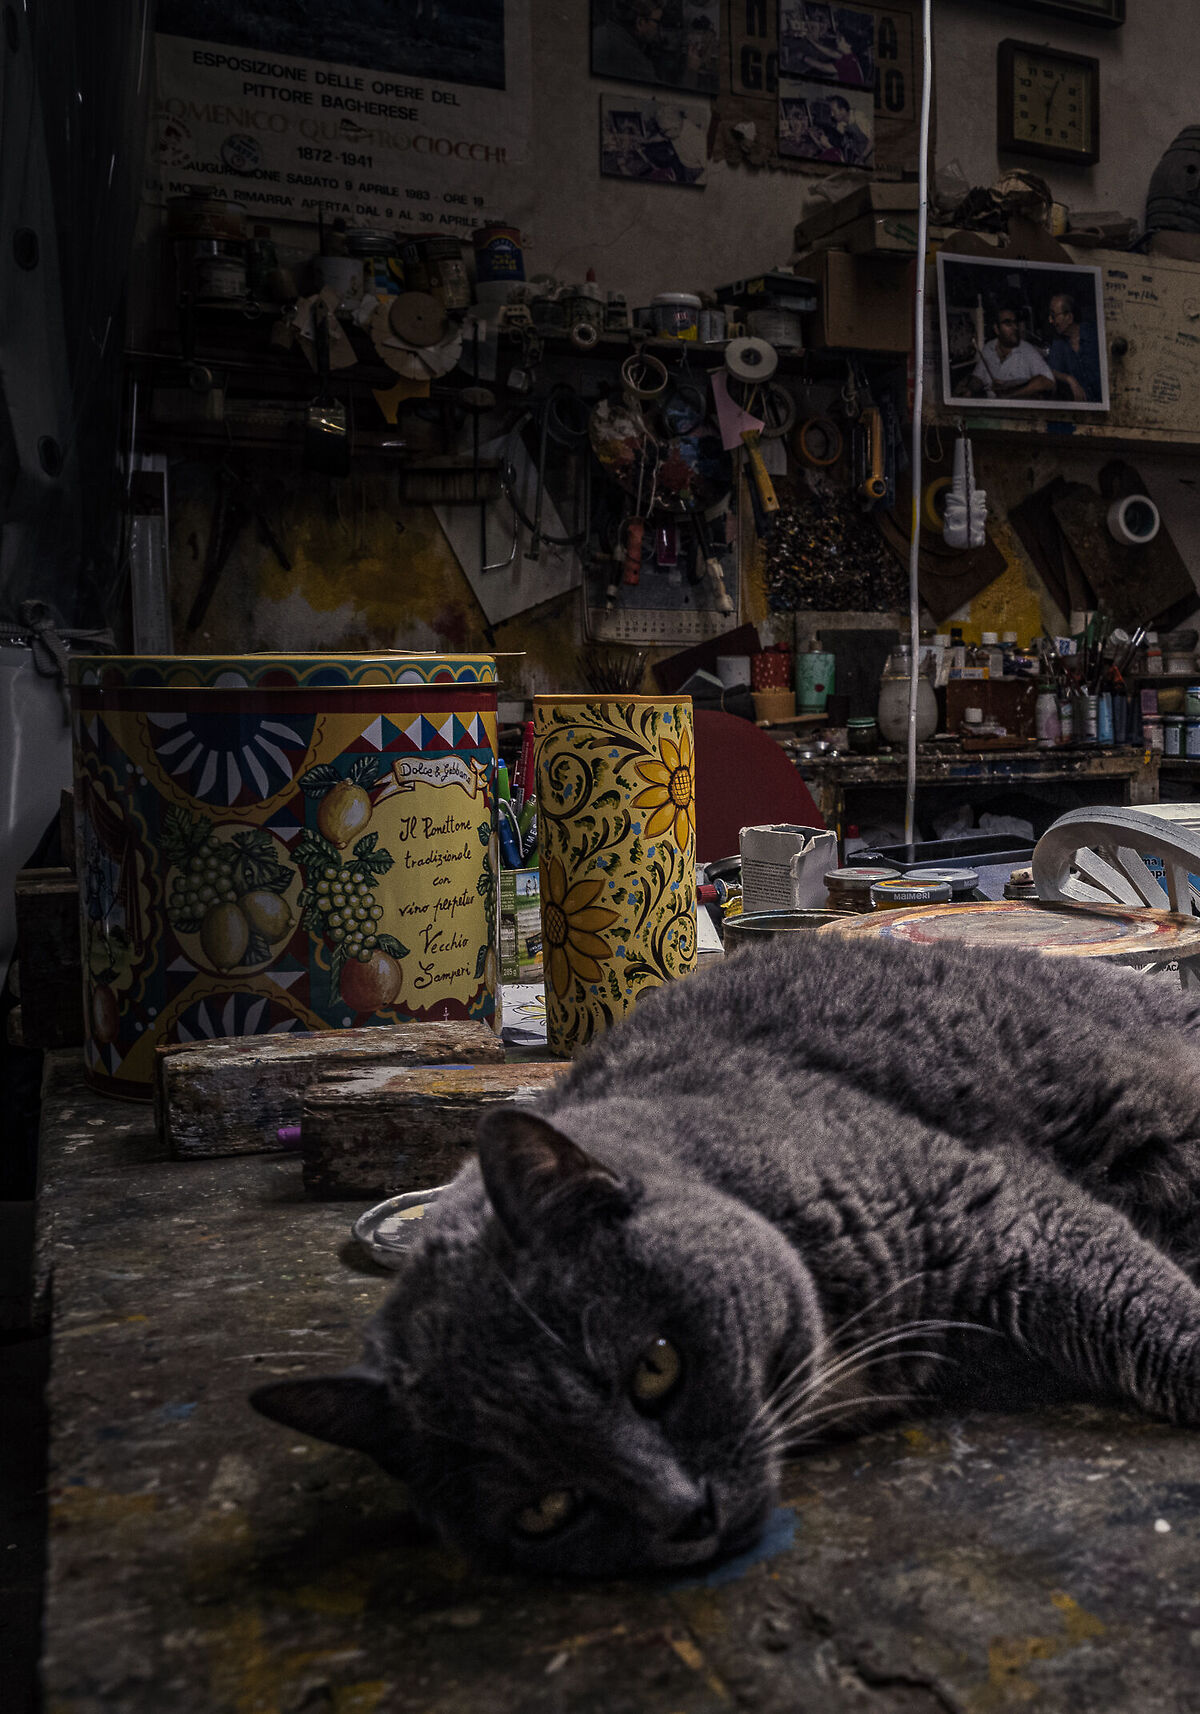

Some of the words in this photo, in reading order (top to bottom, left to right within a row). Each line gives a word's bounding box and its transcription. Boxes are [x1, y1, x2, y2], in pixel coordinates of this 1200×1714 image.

[192, 50, 307, 82] ESPOSIZIONE
[315, 72, 364, 92] DELLE
[372, 81, 425, 101] OPERE
[432, 90, 461, 107] DEL
[243, 81, 313, 106] PITTORE
[321, 95, 419, 121] BAGHERESE
[287, 172, 339, 189] SABATO
[345, 180, 353, 191] 9
[359, 183, 400, 198] APRILE
[405, 188, 431, 201] 1983
[443, 192, 468, 205] ORE
[169, 182, 229, 199] MORA
[302, 198, 351, 213] APERTA
[356, 202, 381, 216] DAL
[385, 207, 394, 218] 9
[399, 210, 413, 220] AL
[420, 211, 434, 222] 30
[439, 213, 478, 227] APRILE
[399, 762, 433, 779] Dolce
[404, 842, 472, 869] tradizionale
[432, 876, 451, 887] con
[399, 902, 430, 917] vino
[419, 923, 469, 954] Vecchio
